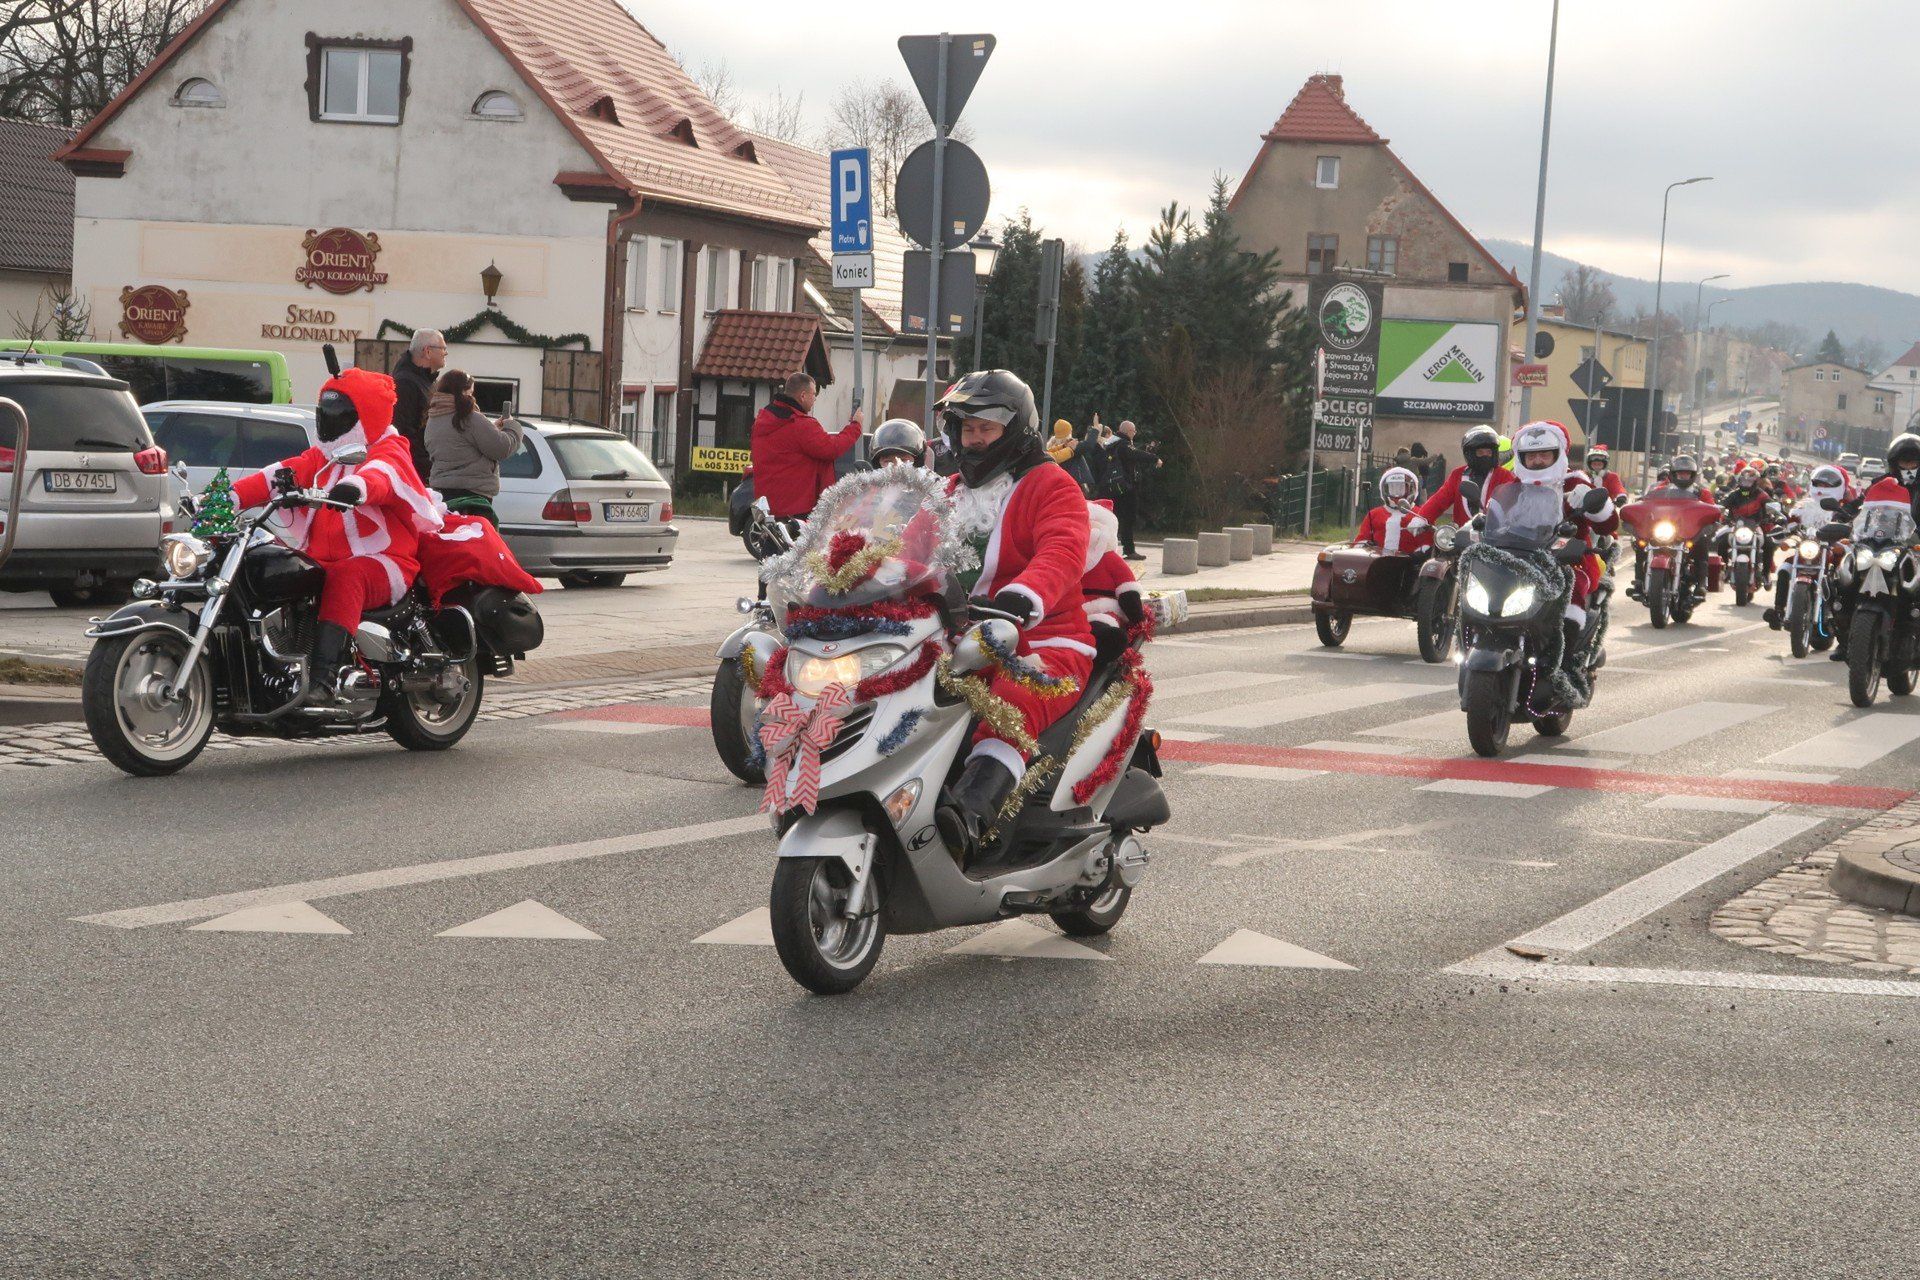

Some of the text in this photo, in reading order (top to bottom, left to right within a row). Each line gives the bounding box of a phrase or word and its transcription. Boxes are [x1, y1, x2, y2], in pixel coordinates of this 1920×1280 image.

[839, 158, 861, 221] P
[838, 234, 856, 245] Płatny
[310, 249, 369, 269] ORIENT
[327, 271, 386, 283] KOLONIALNY
[836, 263, 868, 280] Koniec
[126, 305, 180, 322] ORIENT
[261, 324, 361, 342] KOLONIALNY
[1353, 352, 1374, 365] Zdrój
[1422, 351, 1454, 381] LEROY
[1449, 344, 1486, 383] MERLIN
[1361, 363, 1375, 373] 5/1
[1320, 399, 1373, 416] OCLEGI
[1403, 400, 1484, 413] SZCZAWNO-ZDRÓJ
[1316, 432, 1333, 448] 603
[1335, 434, 1351, 450] 892
[705, 462, 721, 470] 605
[724, 463, 739, 471] 331
[54, 473, 113, 489] DB 6745L
[610, 505, 625, 518] DSW
